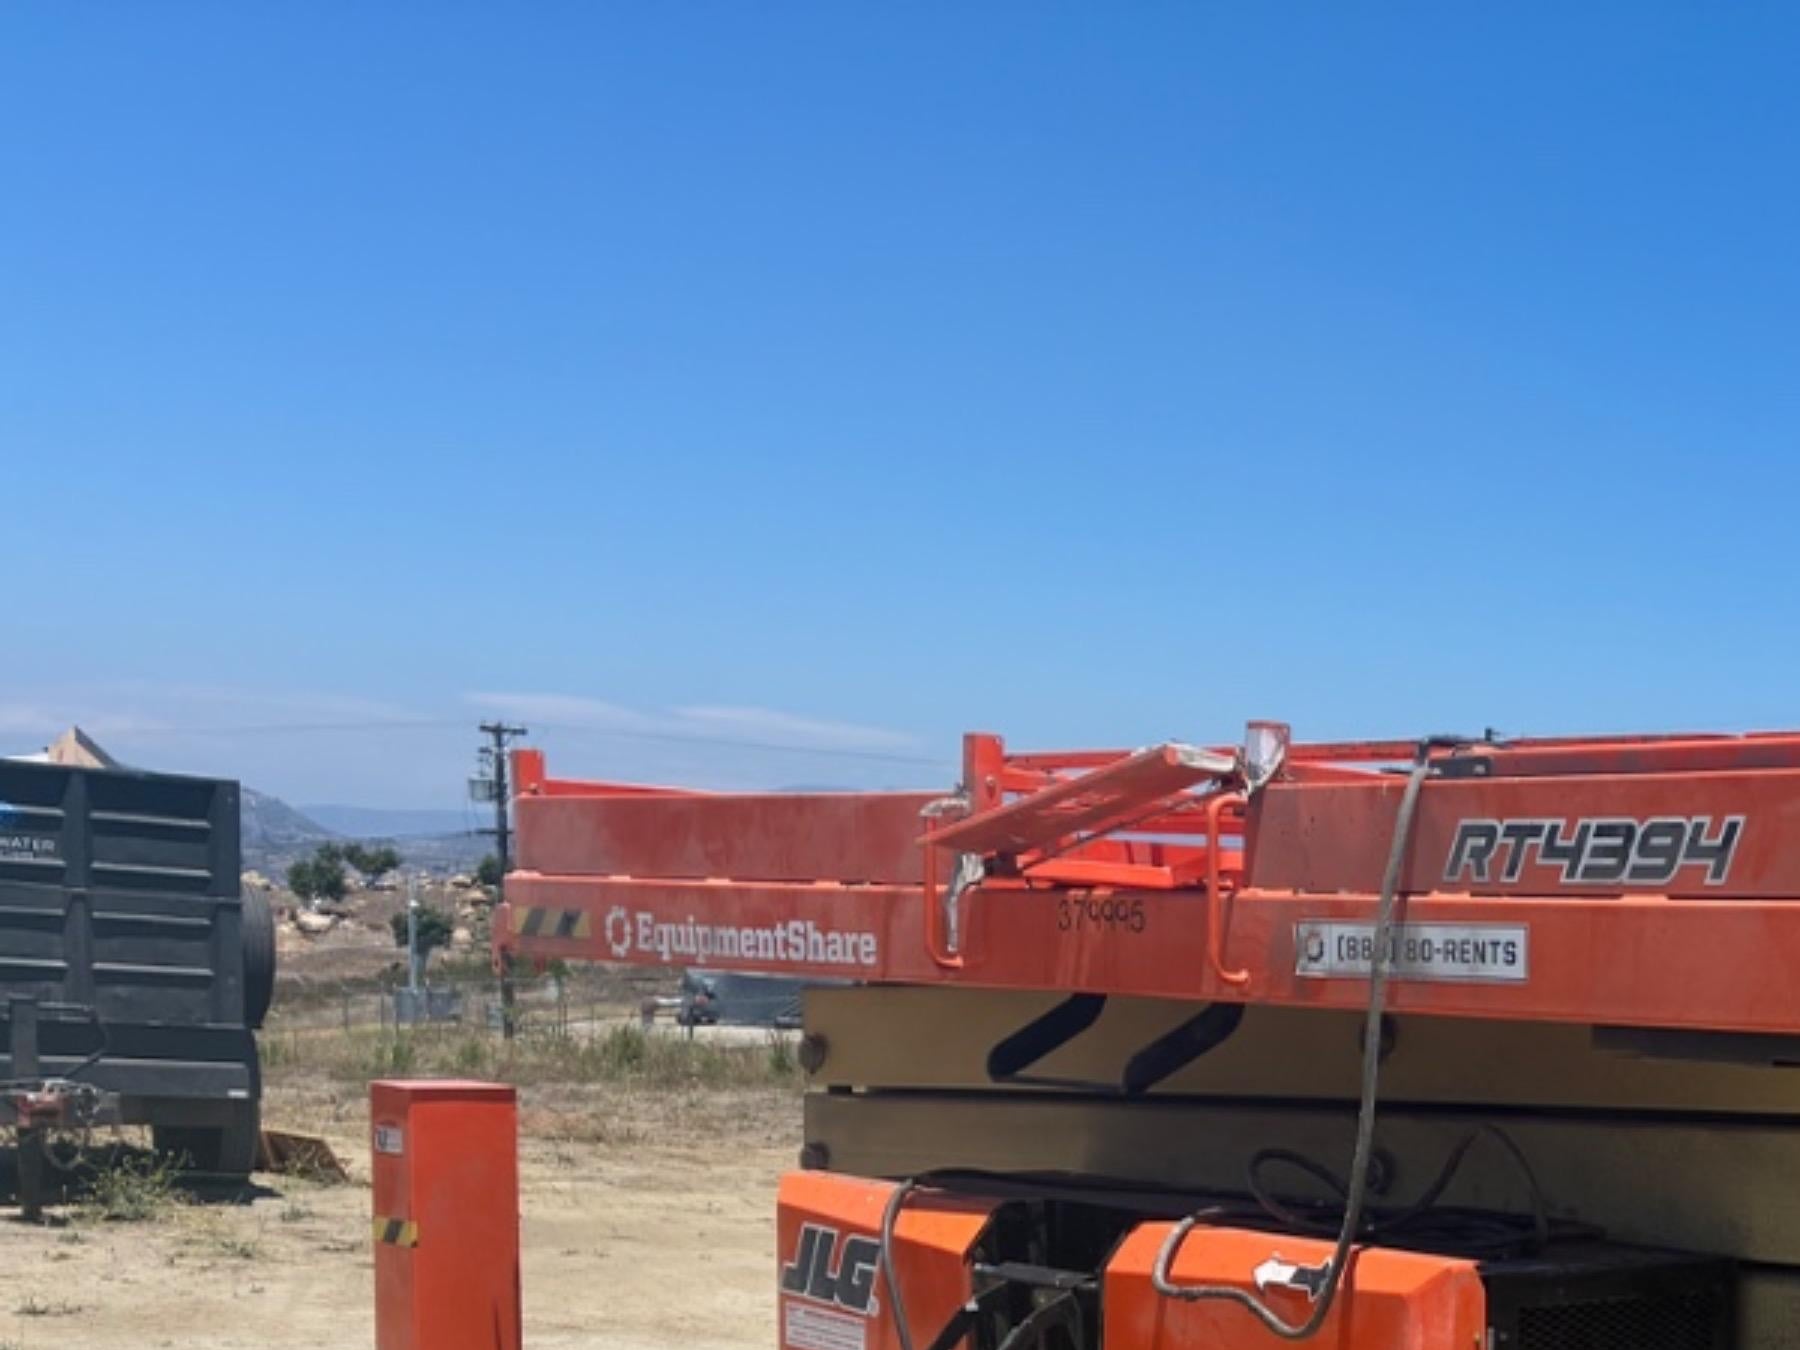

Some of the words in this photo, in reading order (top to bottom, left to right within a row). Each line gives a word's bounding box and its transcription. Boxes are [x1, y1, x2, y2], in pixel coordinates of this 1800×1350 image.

[1442, 815, 1747, 886] RT4394
[635, 912, 878, 964] EquipmentShare
[1057, 898, 1147, 935] 379995
[1406, 937, 1517, 966] 80-RENTS
[782, 1221, 879, 1317] JLG
